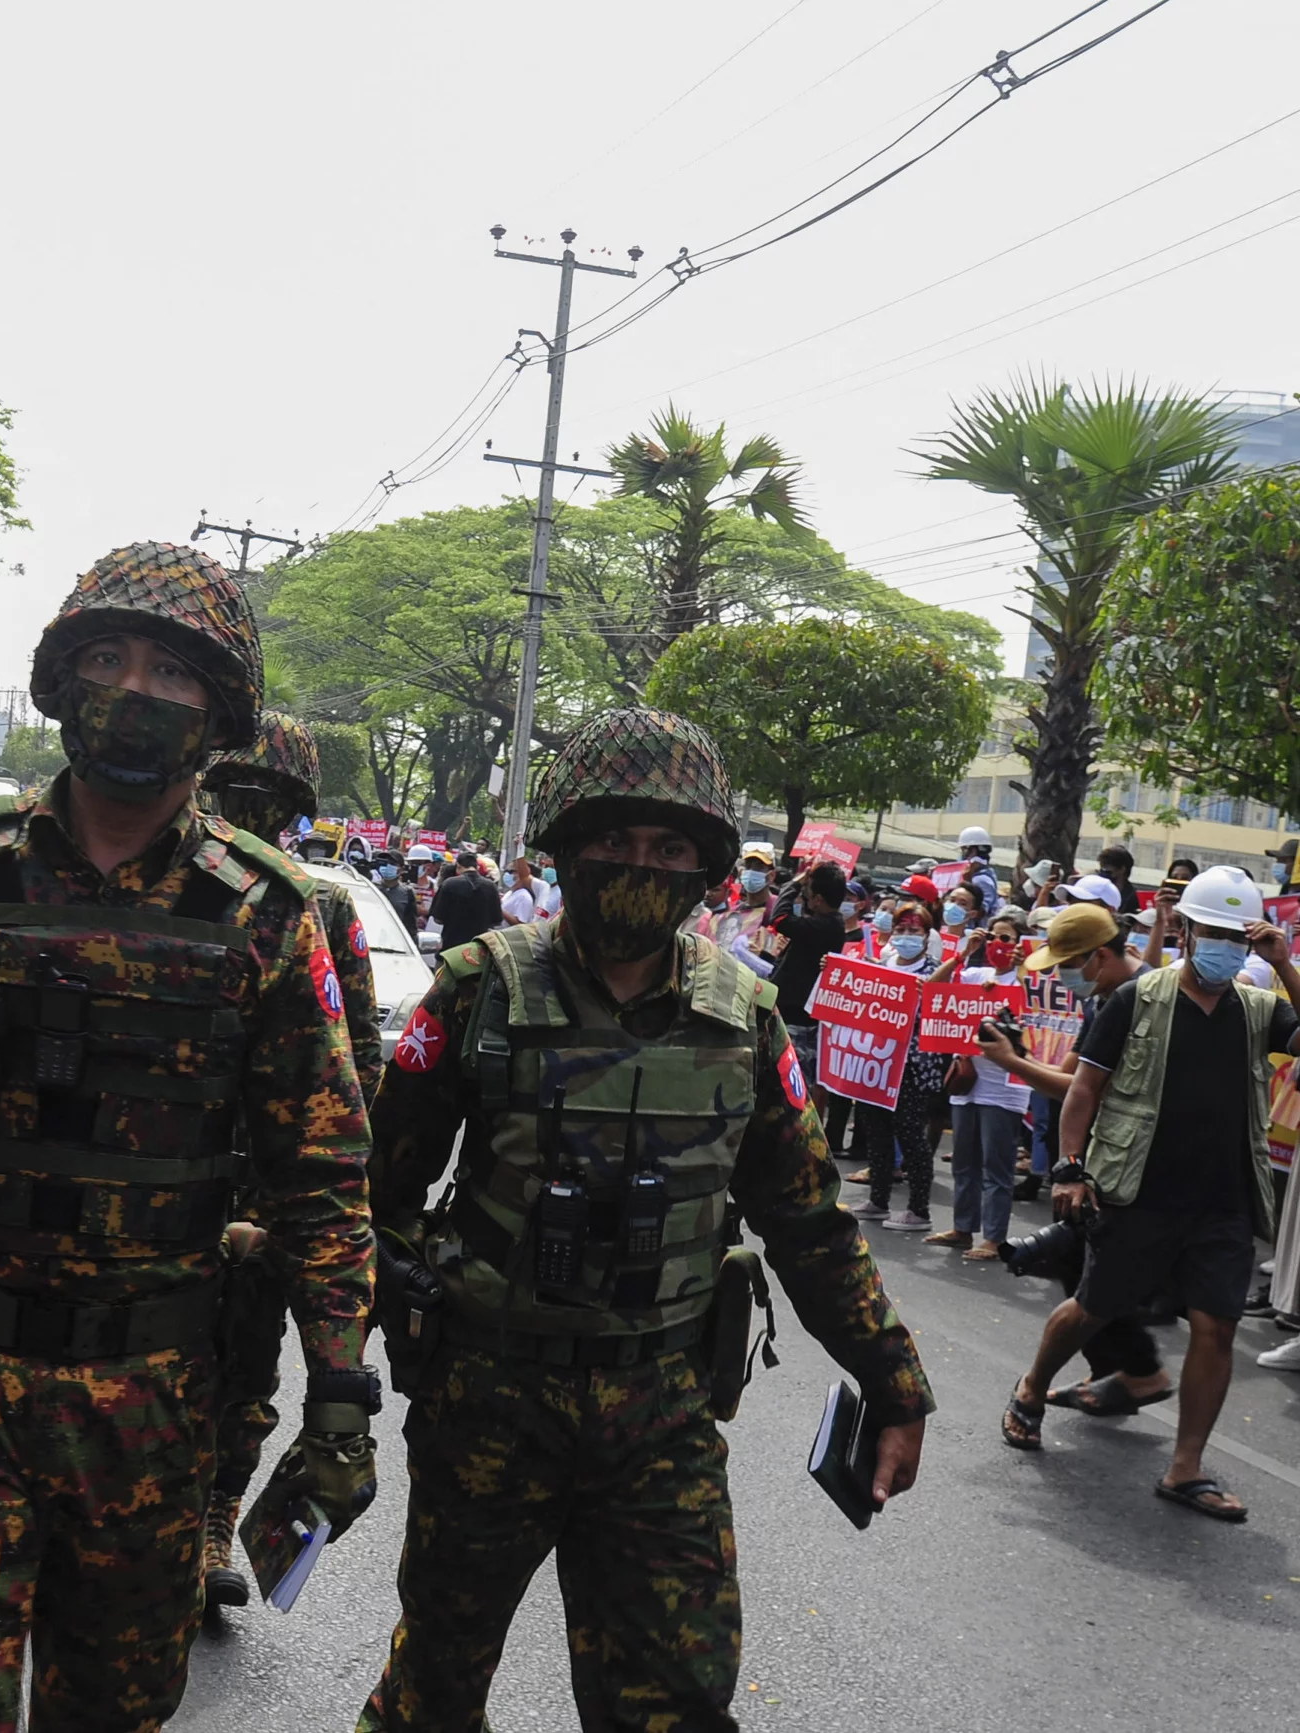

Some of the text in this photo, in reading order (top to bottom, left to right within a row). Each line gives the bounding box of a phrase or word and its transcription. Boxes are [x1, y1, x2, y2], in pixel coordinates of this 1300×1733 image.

[841, 972, 906, 1002] Against
[816, 988, 908, 1030] Military Coup
[921, 1019, 973, 1043] Military
